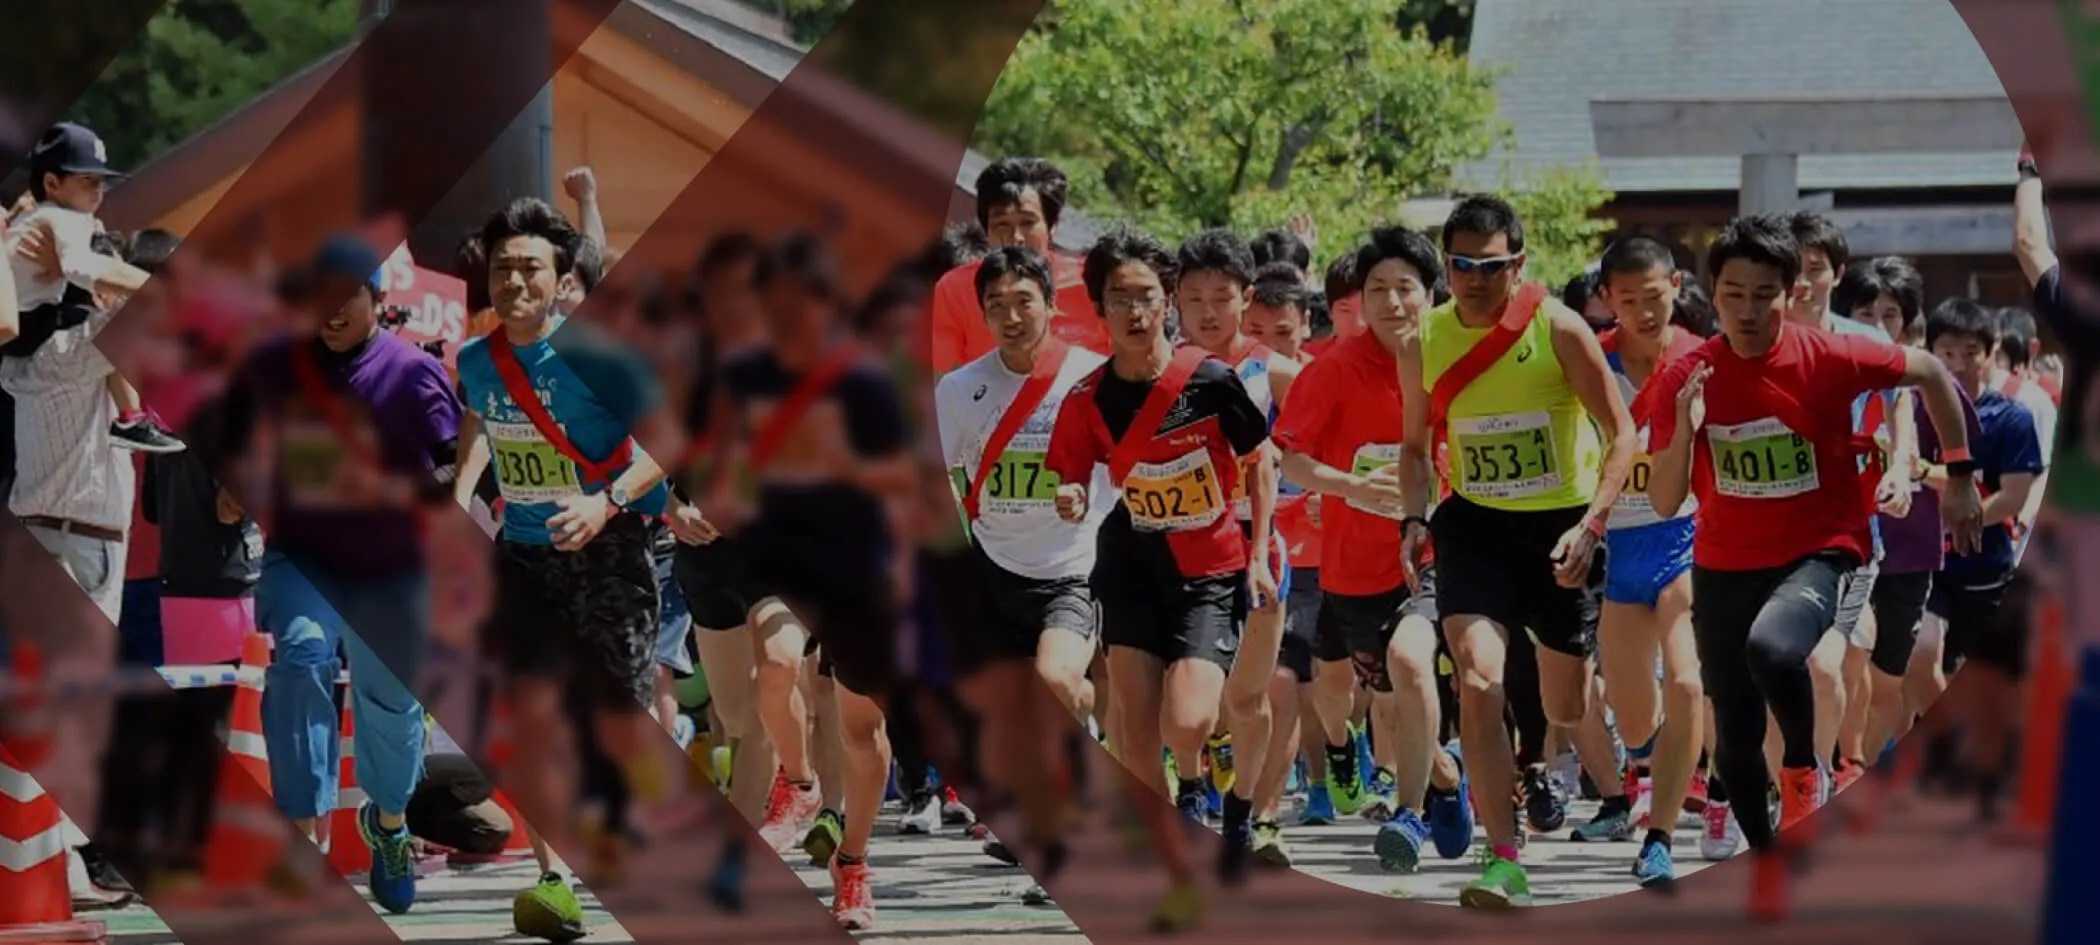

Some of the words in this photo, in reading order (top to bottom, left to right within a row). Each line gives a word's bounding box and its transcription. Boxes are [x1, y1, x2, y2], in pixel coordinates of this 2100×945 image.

[1534, 429, 1546, 445] A
[1194, 467, 1206, 482] B
[1464, 444, 1548, 481] 353-1
[1722, 447, 1810, 481] 401-8
[1126, 485, 1214, 518] 502-1
